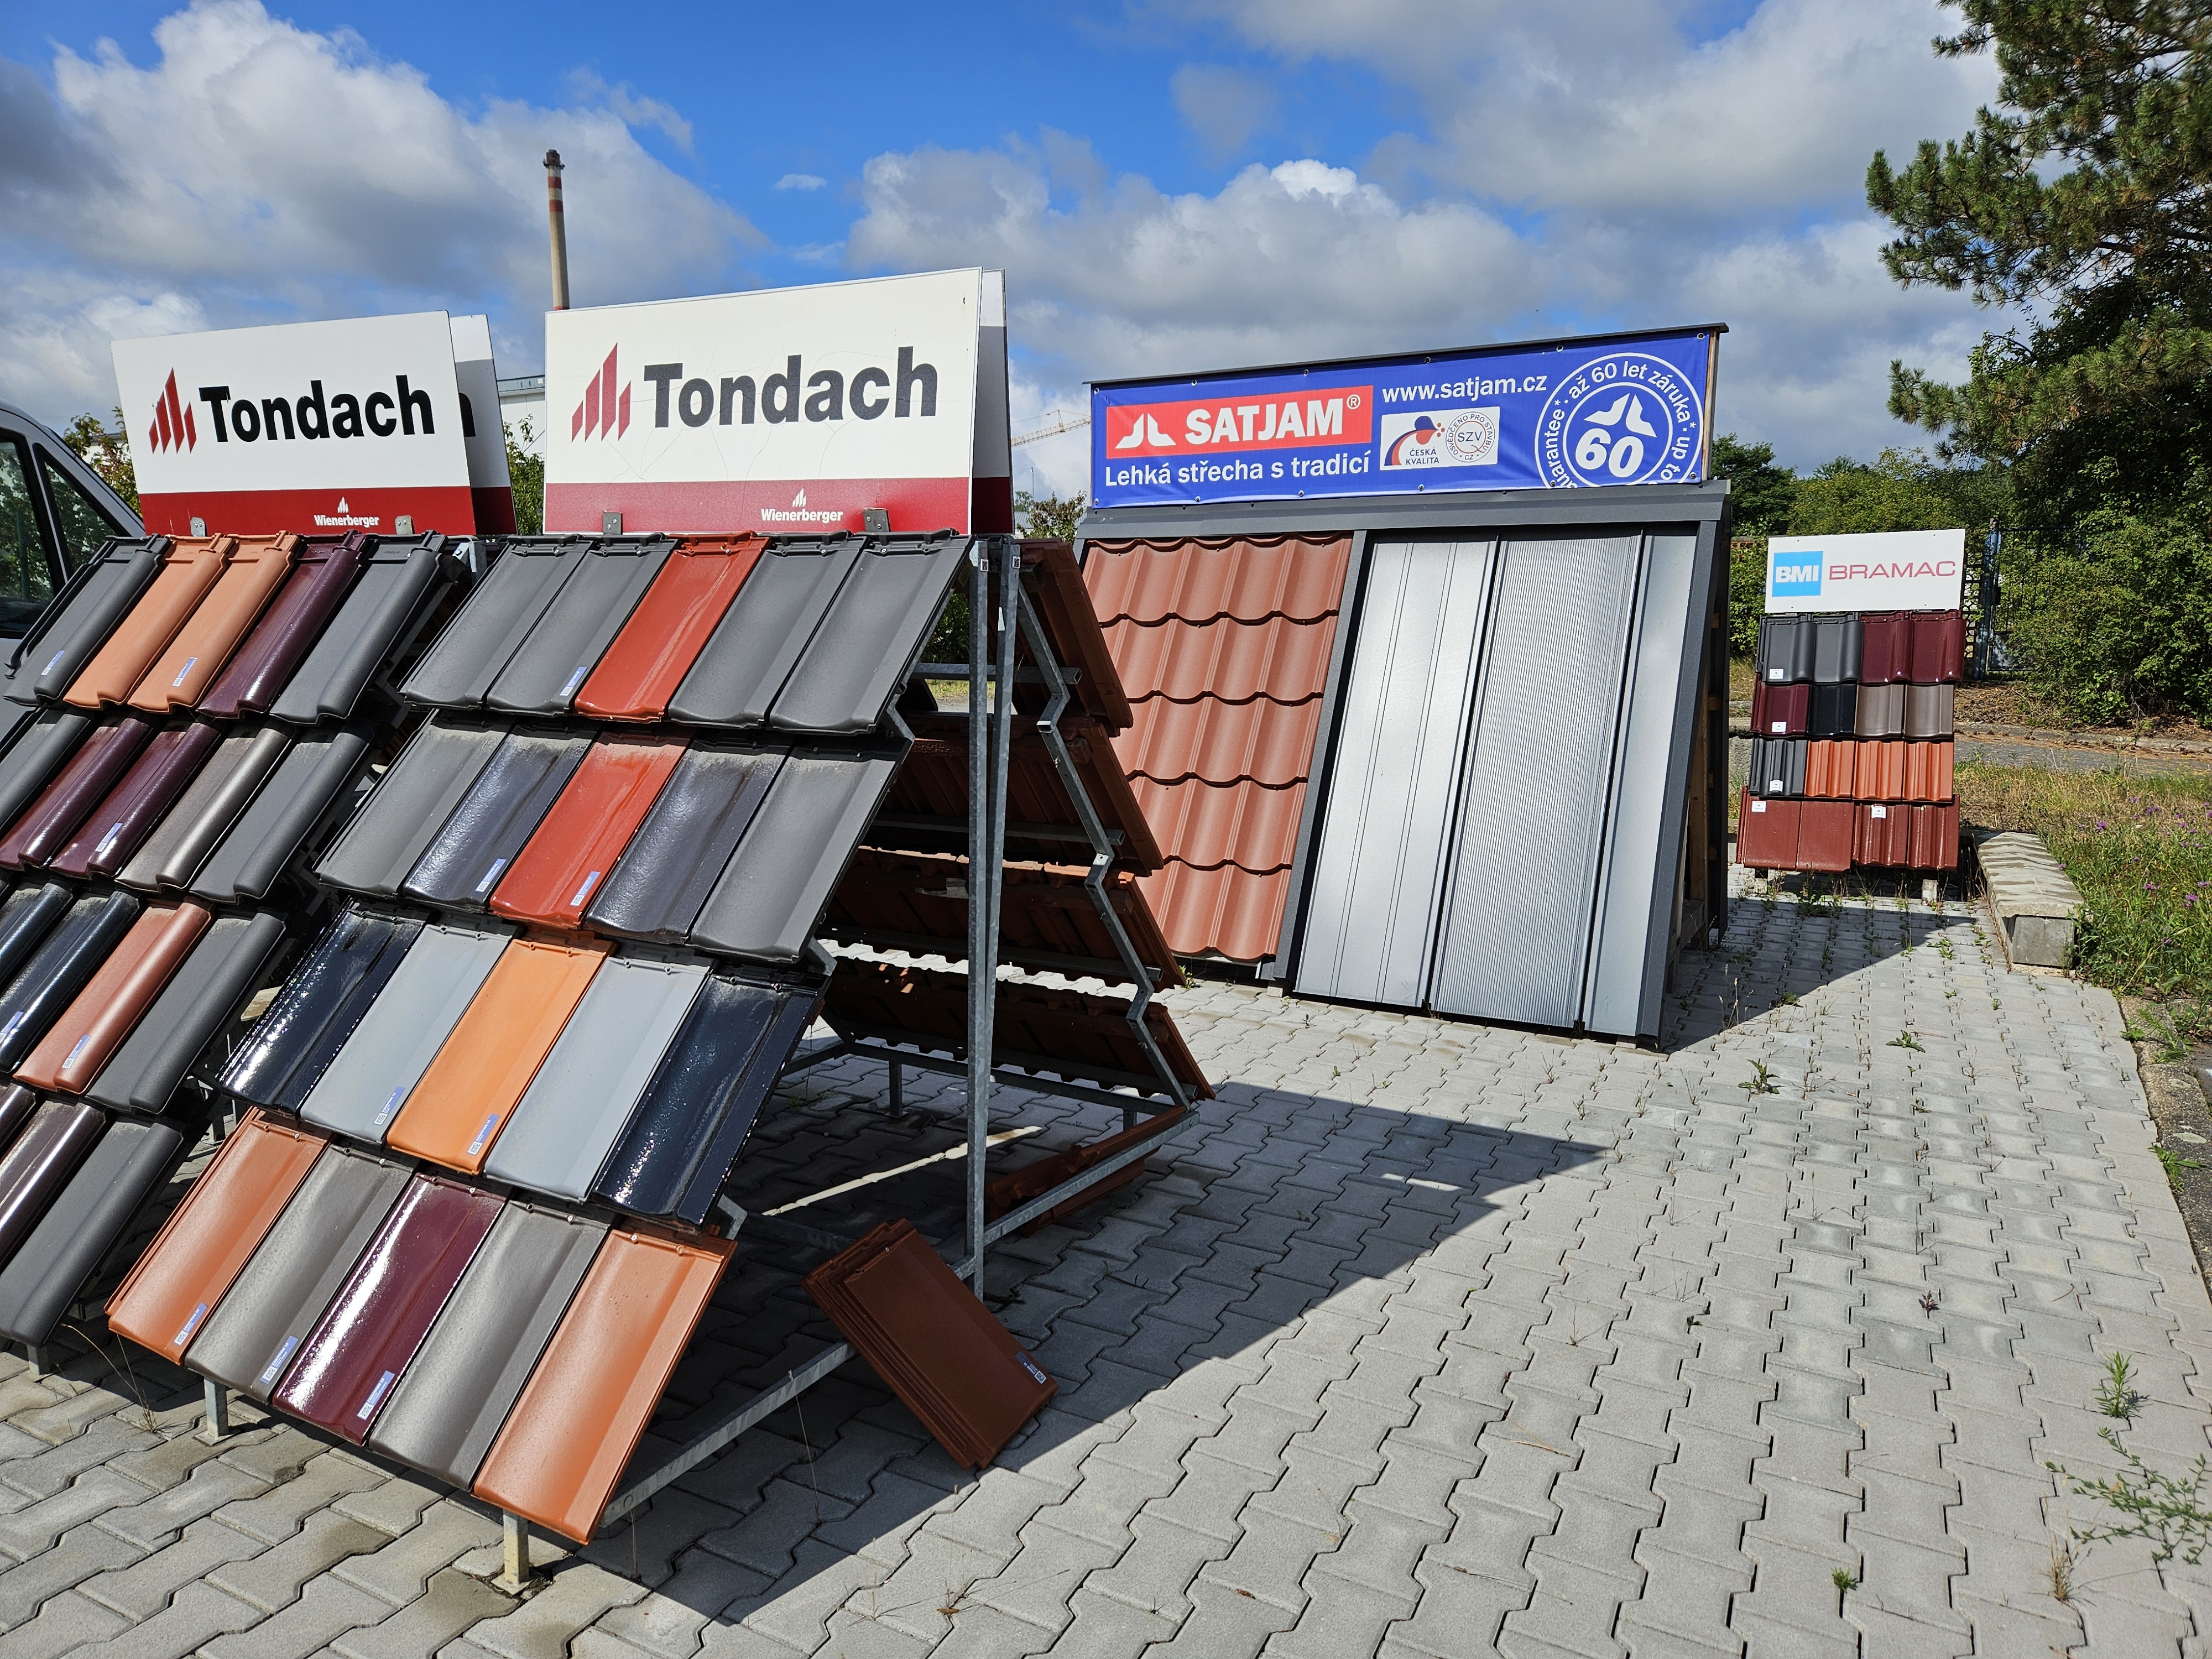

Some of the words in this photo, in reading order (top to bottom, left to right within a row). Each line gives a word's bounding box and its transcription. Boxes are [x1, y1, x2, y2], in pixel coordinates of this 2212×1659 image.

[644, 346, 938, 429] Tondach
[1383, 374, 1547, 403] www.satjam.cz
[1569, 374, 1590, 399] až
[1591, 363, 1618, 383] 60
[1623, 361, 1648, 379] let
[199, 374, 435, 442] Tondach
[1447, 415, 1468, 455] OSVĚDČENO
[1470, 414, 1485, 422] PRO
[1483, 422, 1493, 451] STAVBU
[1457, 431, 1483, 442] SZV
[1409, 446, 1437, 456] ČESKÁ
[1575, 427, 1644, 478] 60
[1671, 436, 1691, 460] up
[1106, 462, 1171, 486] Lehká
[1178, 460, 1263, 483] střecha
[1271, 461, 1284, 478] s
[1291, 450, 1371, 477] tradicí
[1406, 457, 1439, 465] KVALITA
[1660, 463, 1681, 481] to
[314, 513, 379, 529] Wienerberger
[761, 507, 844, 524] Wienerberger
[1775, 564, 1819, 583] BMI
[1829, 560, 1957, 581] BRAMAC
